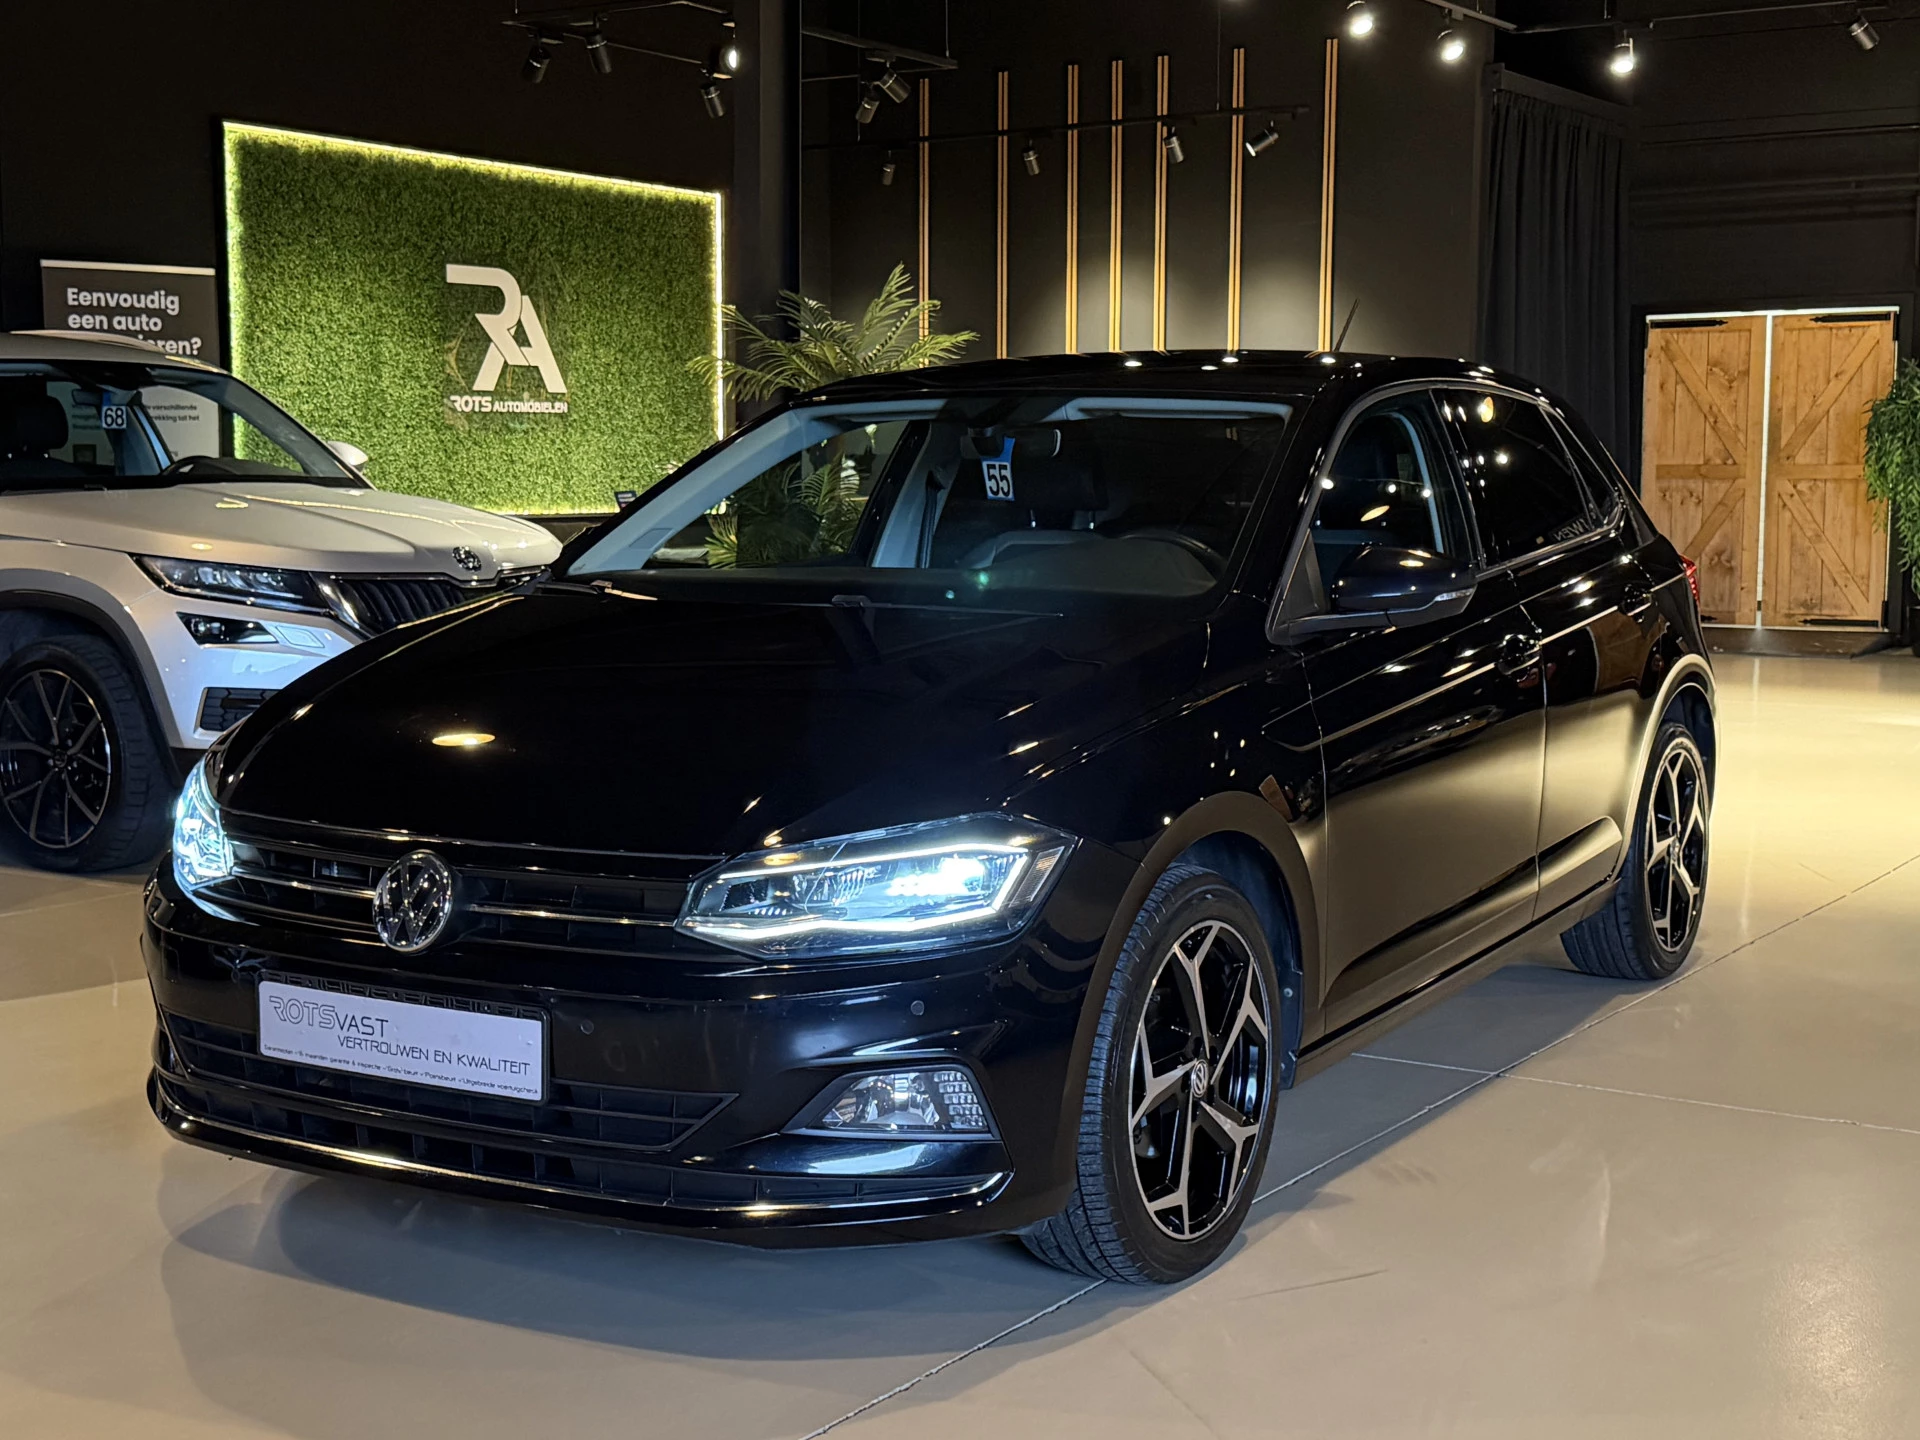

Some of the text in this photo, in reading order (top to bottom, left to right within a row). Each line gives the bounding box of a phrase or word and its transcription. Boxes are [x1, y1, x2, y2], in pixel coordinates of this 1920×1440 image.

[67, 288, 180, 315] Eenvoudig
[68, 313, 163, 331] een auto
[450, 395, 568, 413] ROTS AUTOMOBIELEN
[103, 407, 125, 427] 68
[986, 463, 1011, 497] 55
[337, 1034, 531, 1076] VERTROUWEN EN KWALITEIT
